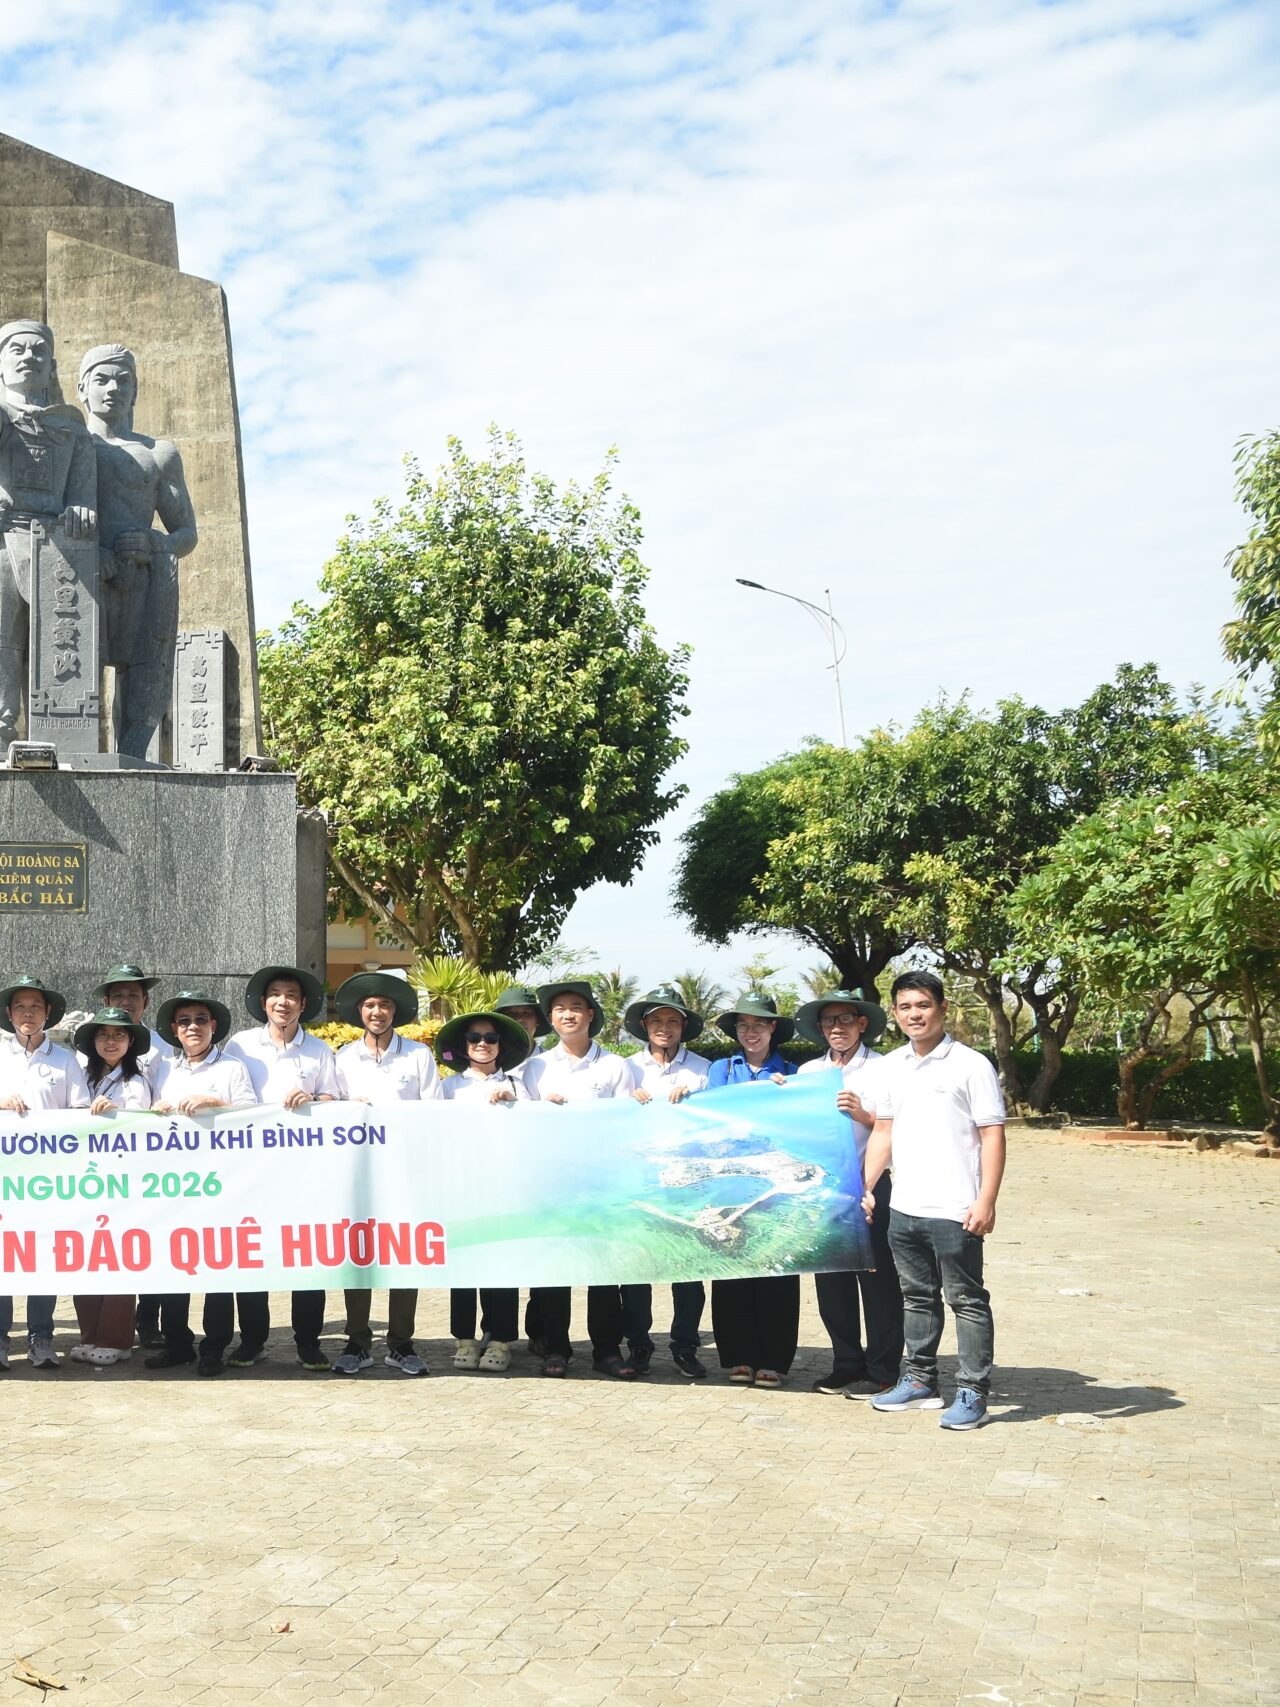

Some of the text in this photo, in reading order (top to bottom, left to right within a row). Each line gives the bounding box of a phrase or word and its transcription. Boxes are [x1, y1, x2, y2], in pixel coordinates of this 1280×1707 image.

[16, 852, 61, 868] HOÀNG
[64, 856, 81, 868] SA
[35, 871, 74, 887] QUẢN
[39, 888, 74, 905] HẢI
[88, 1133, 137, 1159] MẠI
[146, 1121, 200, 1151] DẦU
[210, 1123, 254, 1150] KHÍ
[263, 1122, 323, 1148] BÌNH
[333, 1124, 386, 1146] SƠN
[3, 1161, 129, 1201] NGUỒN
[142, 1172, 222, 1198] 2026
[52, 1214, 151, 1272] ĐẢO
[169, 1216, 264, 1276] QUÊ
[281, 1218, 446, 1268] HƯƠNG
